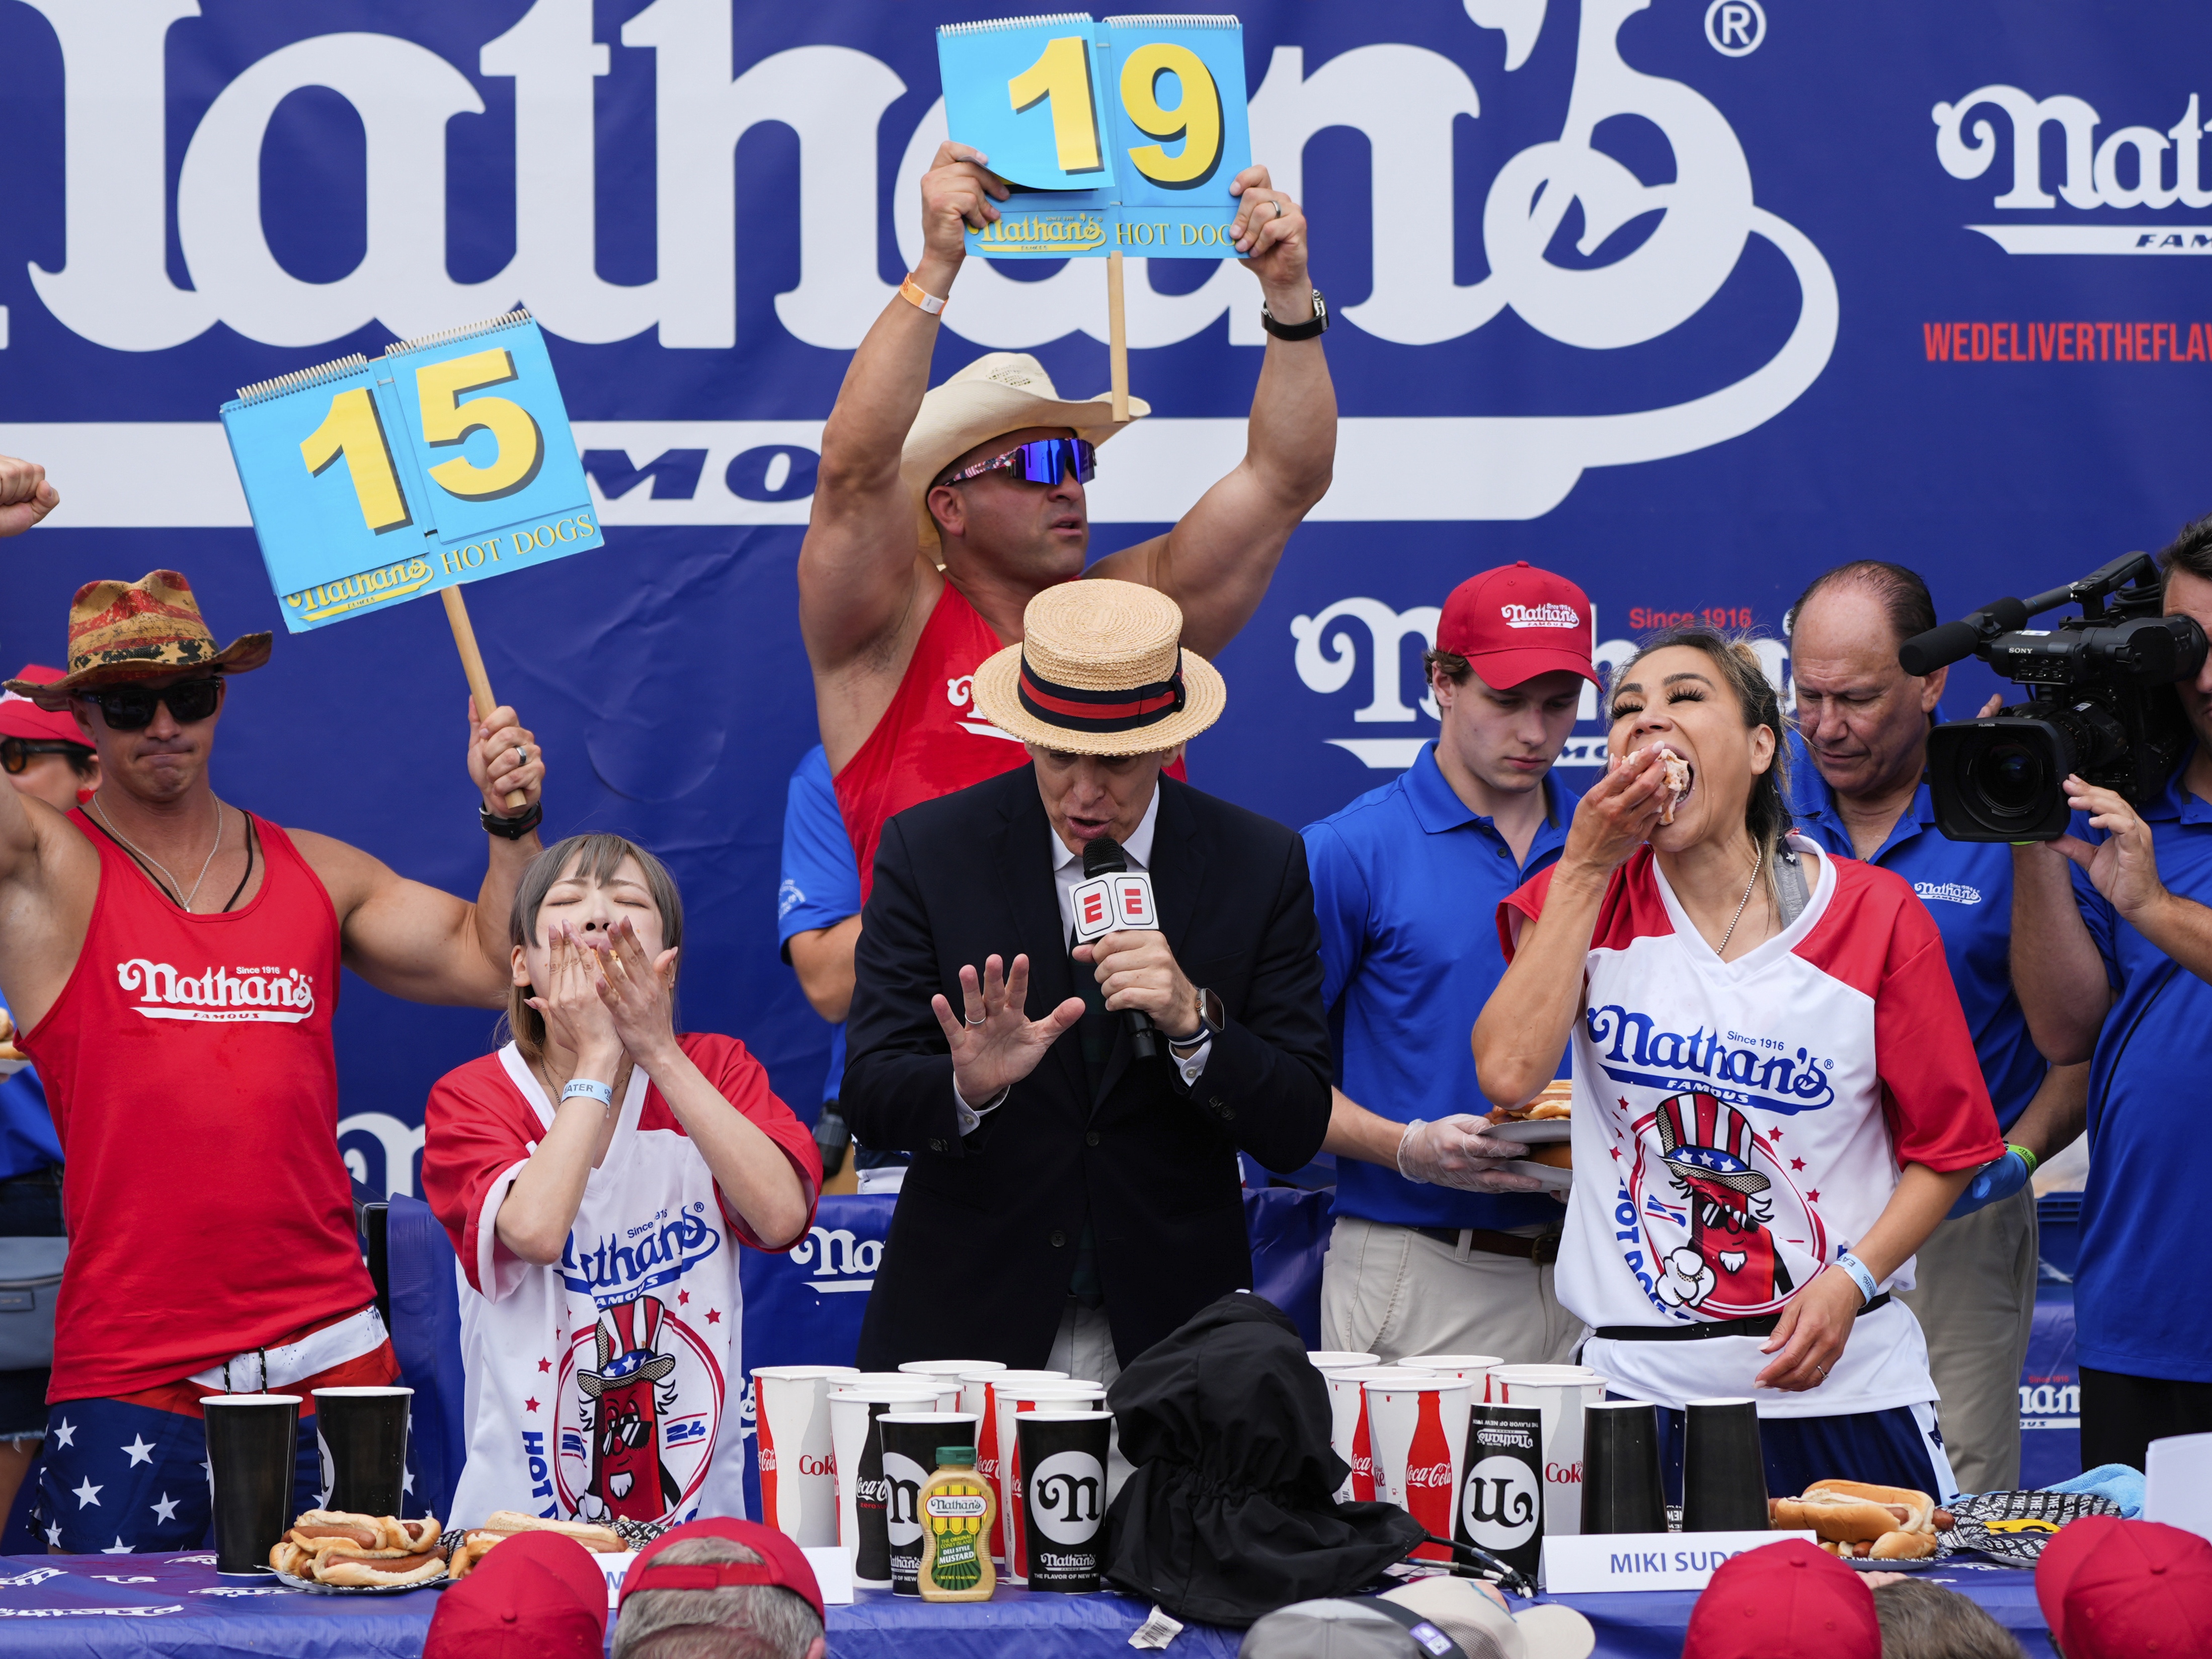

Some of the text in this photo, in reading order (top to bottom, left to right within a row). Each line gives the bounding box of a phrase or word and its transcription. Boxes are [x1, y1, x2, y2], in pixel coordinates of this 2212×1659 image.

[1008, 36, 1223, 188] 19
[1116, 223, 1170, 246] HOT
[1180, 223, 1236, 247] DOG
[299, 347, 541, 533] 15
[439, 538, 502, 575] HOT
[511, 514, 595, 555] DOGS
[1501, 604, 1578, 622] Nathan's
[1629, 607, 1752, 628] Since 1916
[1914, 882, 1979, 900] Nathan's
[236, 966, 280, 975] Since 1916
[117, 959, 311, 1008] Nathan's
[1727, 1031, 1784, 1051] Since 1916
[1587, 1004, 1828, 1099] Nathan's
[1667, 1079, 1750, 1103] FAMOUS
[627, 1219, 654, 1238] Since
[2029, 1375, 2050, 1383] Since
[666, 1420, 706, 1443] 24
[1478, 1432, 1533, 1449] Nathan's
[522, 1431, 554, 1498] HOT
[799, 1455, 834, 1475] Cok
[1545, 1462, 1583, 1484] Cok
[1407, 1463, 1452, 1488] Coca-Cola
[931, 1498, 981, 1510] Nathan's
[1037, 1473, 1099, 1522] N
[2029, 1495, 2044, 1511] THE
[2047, 1494, 2061, 1510] THE
[939, 1551, 975, 1564] MUSTARD
[955, 1545, 970, 1553] STYLE
[1040, 1552, 1095, 1567] Nathan's
[1611, 1551, 1745, 1573] MIKI SUD
